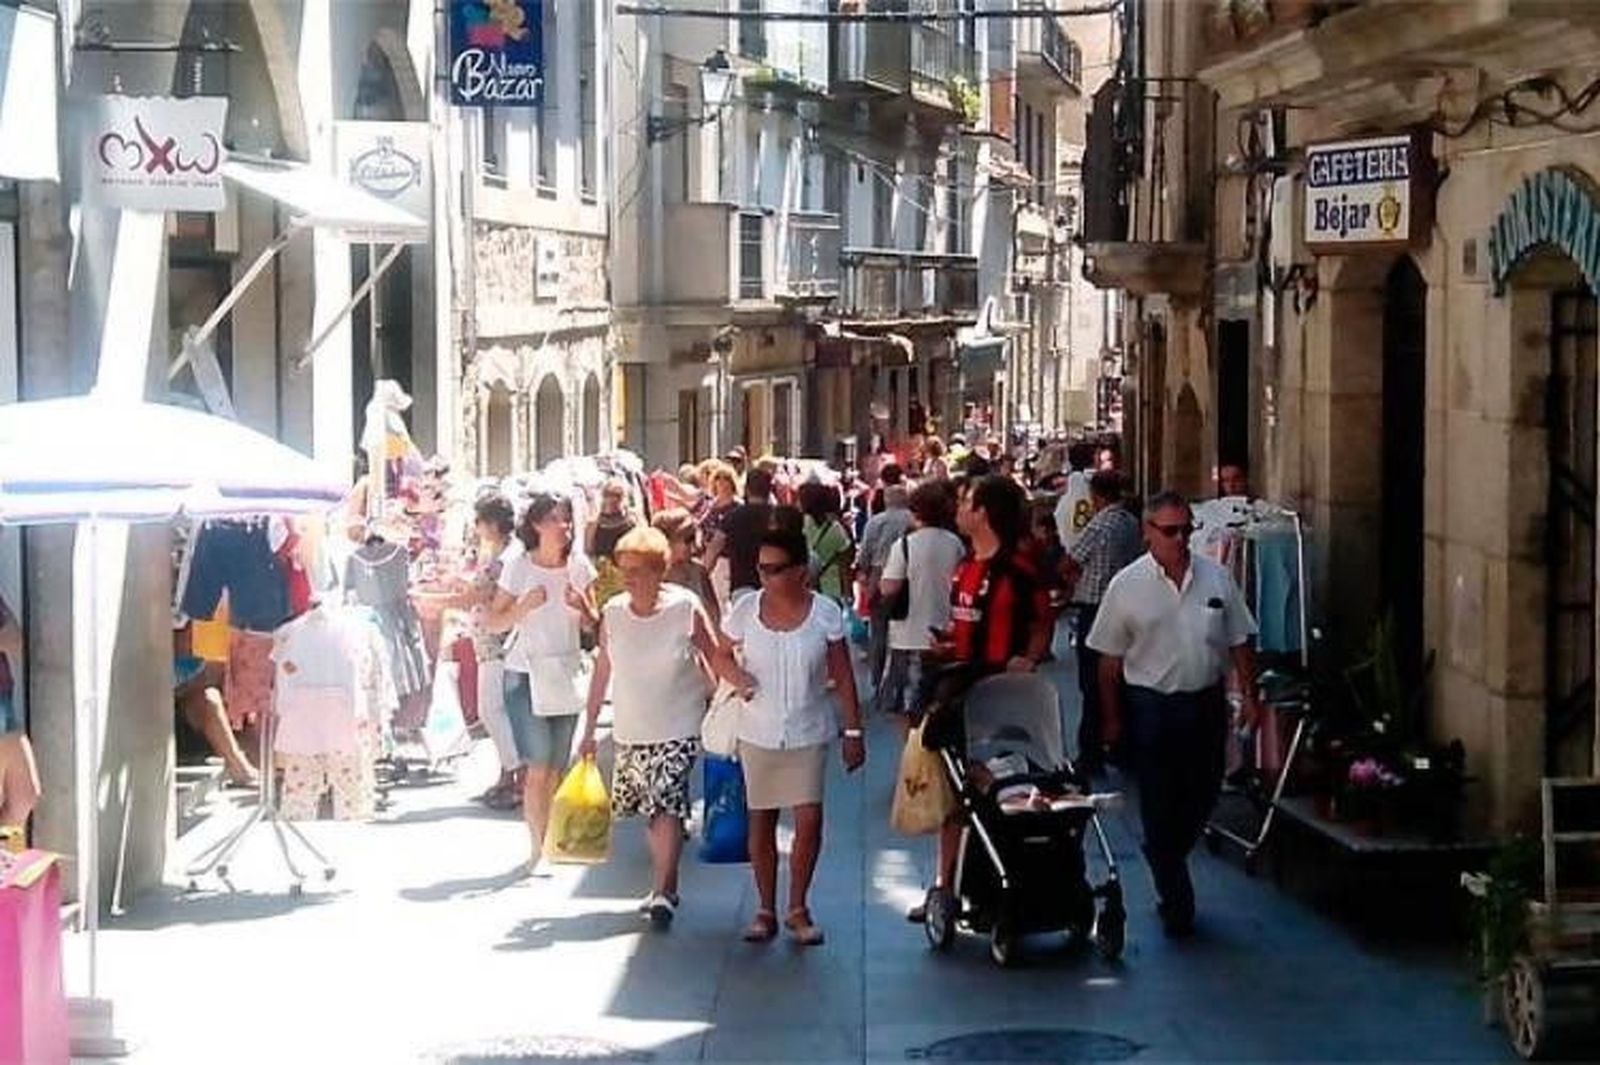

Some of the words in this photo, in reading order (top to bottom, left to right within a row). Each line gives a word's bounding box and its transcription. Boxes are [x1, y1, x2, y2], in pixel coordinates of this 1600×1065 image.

[453, 48, 543, 101] Bazar
[1310, 146, 1409, 186] CAFETERIA
[1314, 193, 1371, 238] Béjar
